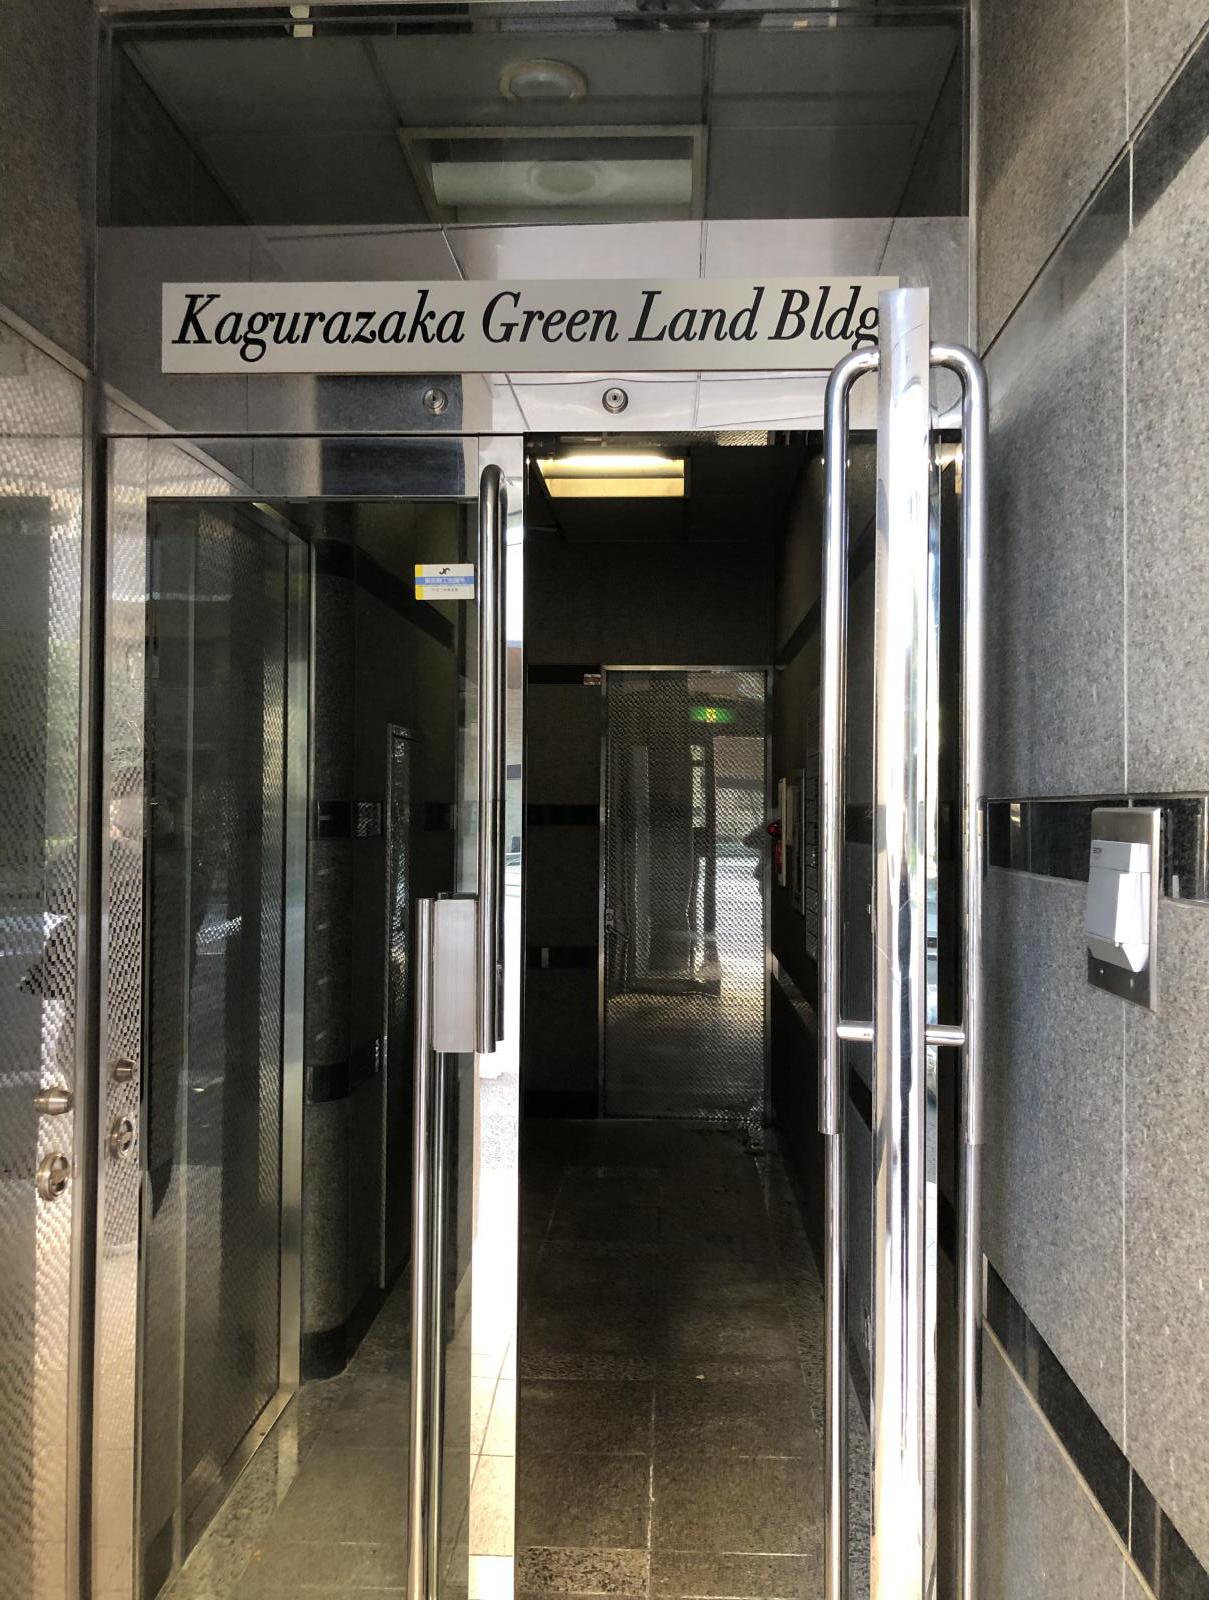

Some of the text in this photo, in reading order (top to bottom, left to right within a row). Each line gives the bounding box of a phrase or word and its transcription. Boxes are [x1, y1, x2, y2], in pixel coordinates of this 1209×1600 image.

[171, 285, 880, 363] Kagurazaka Green Land Bldg
